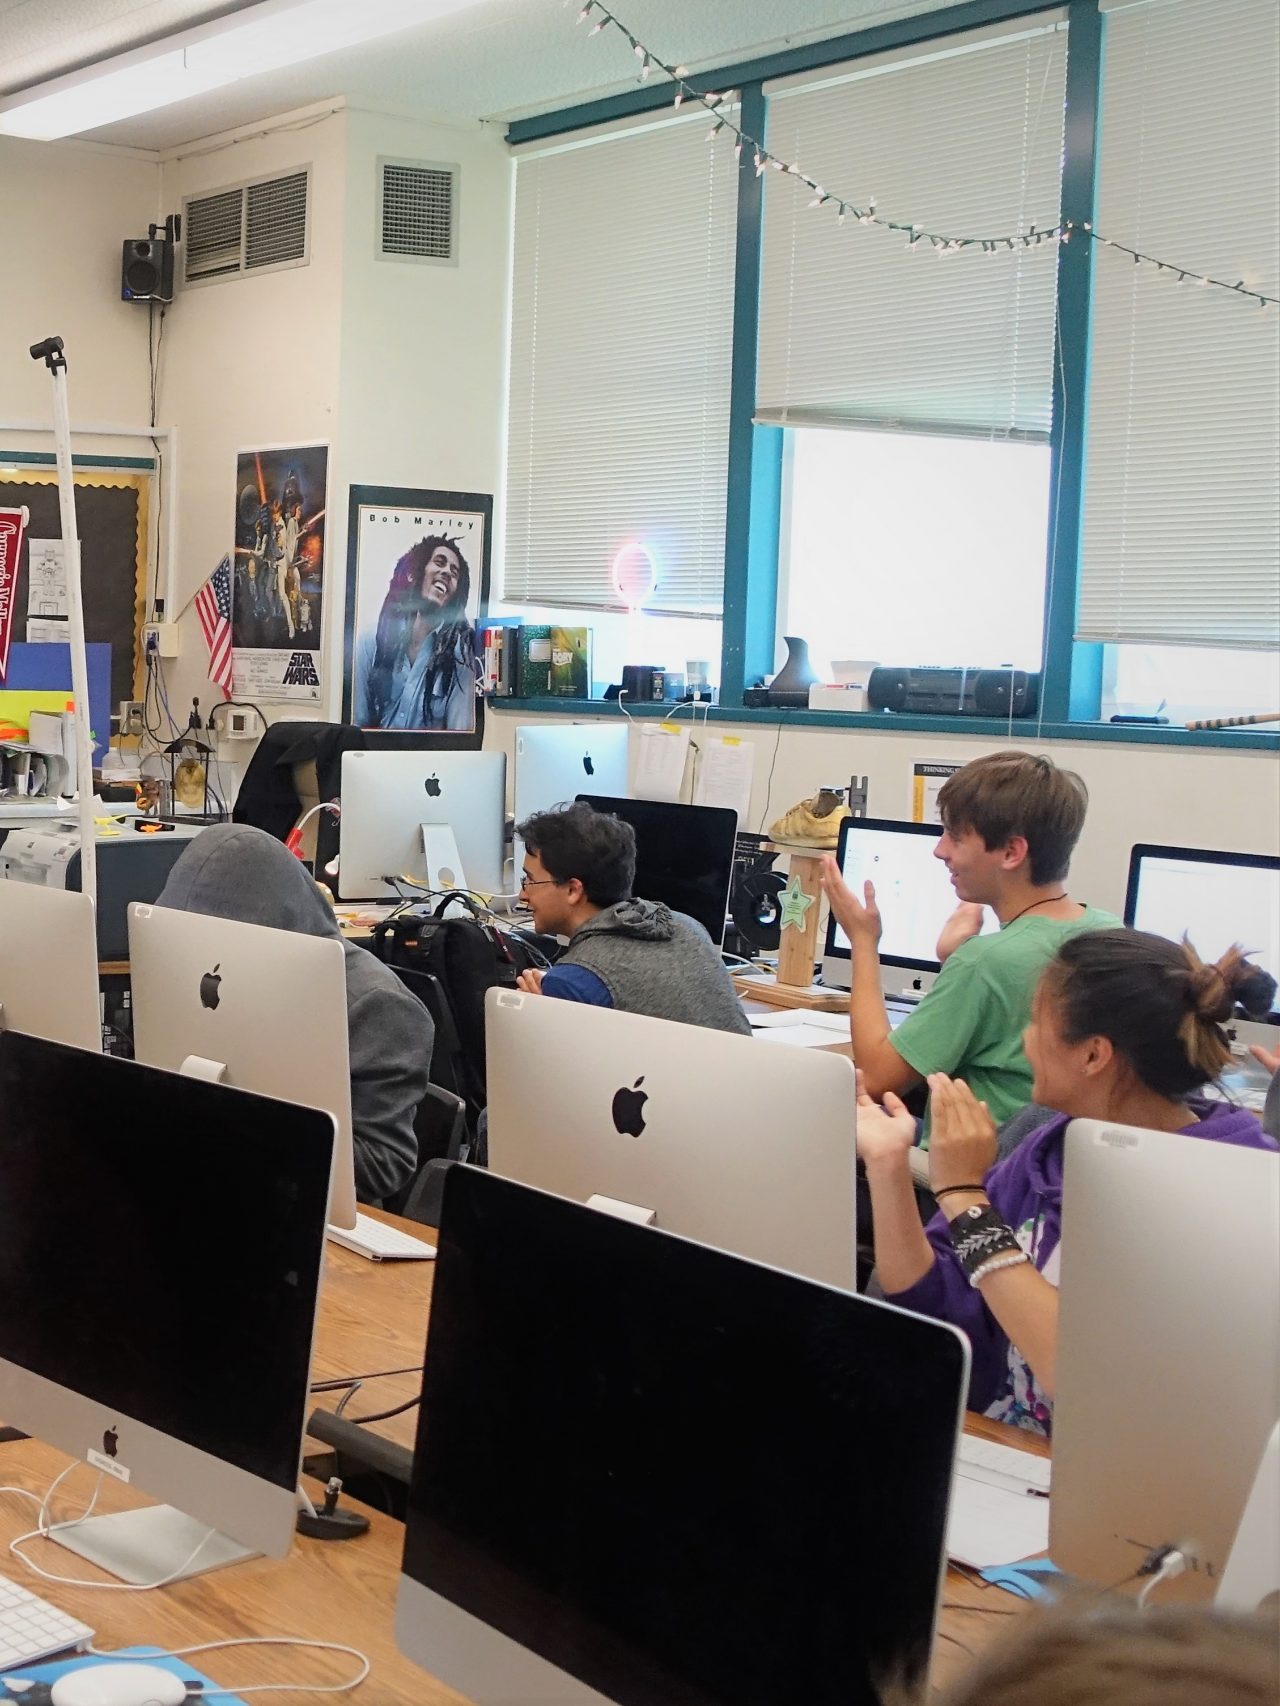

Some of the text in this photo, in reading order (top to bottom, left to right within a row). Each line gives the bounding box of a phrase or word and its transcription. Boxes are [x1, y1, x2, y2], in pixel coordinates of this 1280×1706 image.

[370, 514, 474, 530] Bob Marley
[288, 652, 315, 668] STAR
[282, 667, 320, 687] WARS
